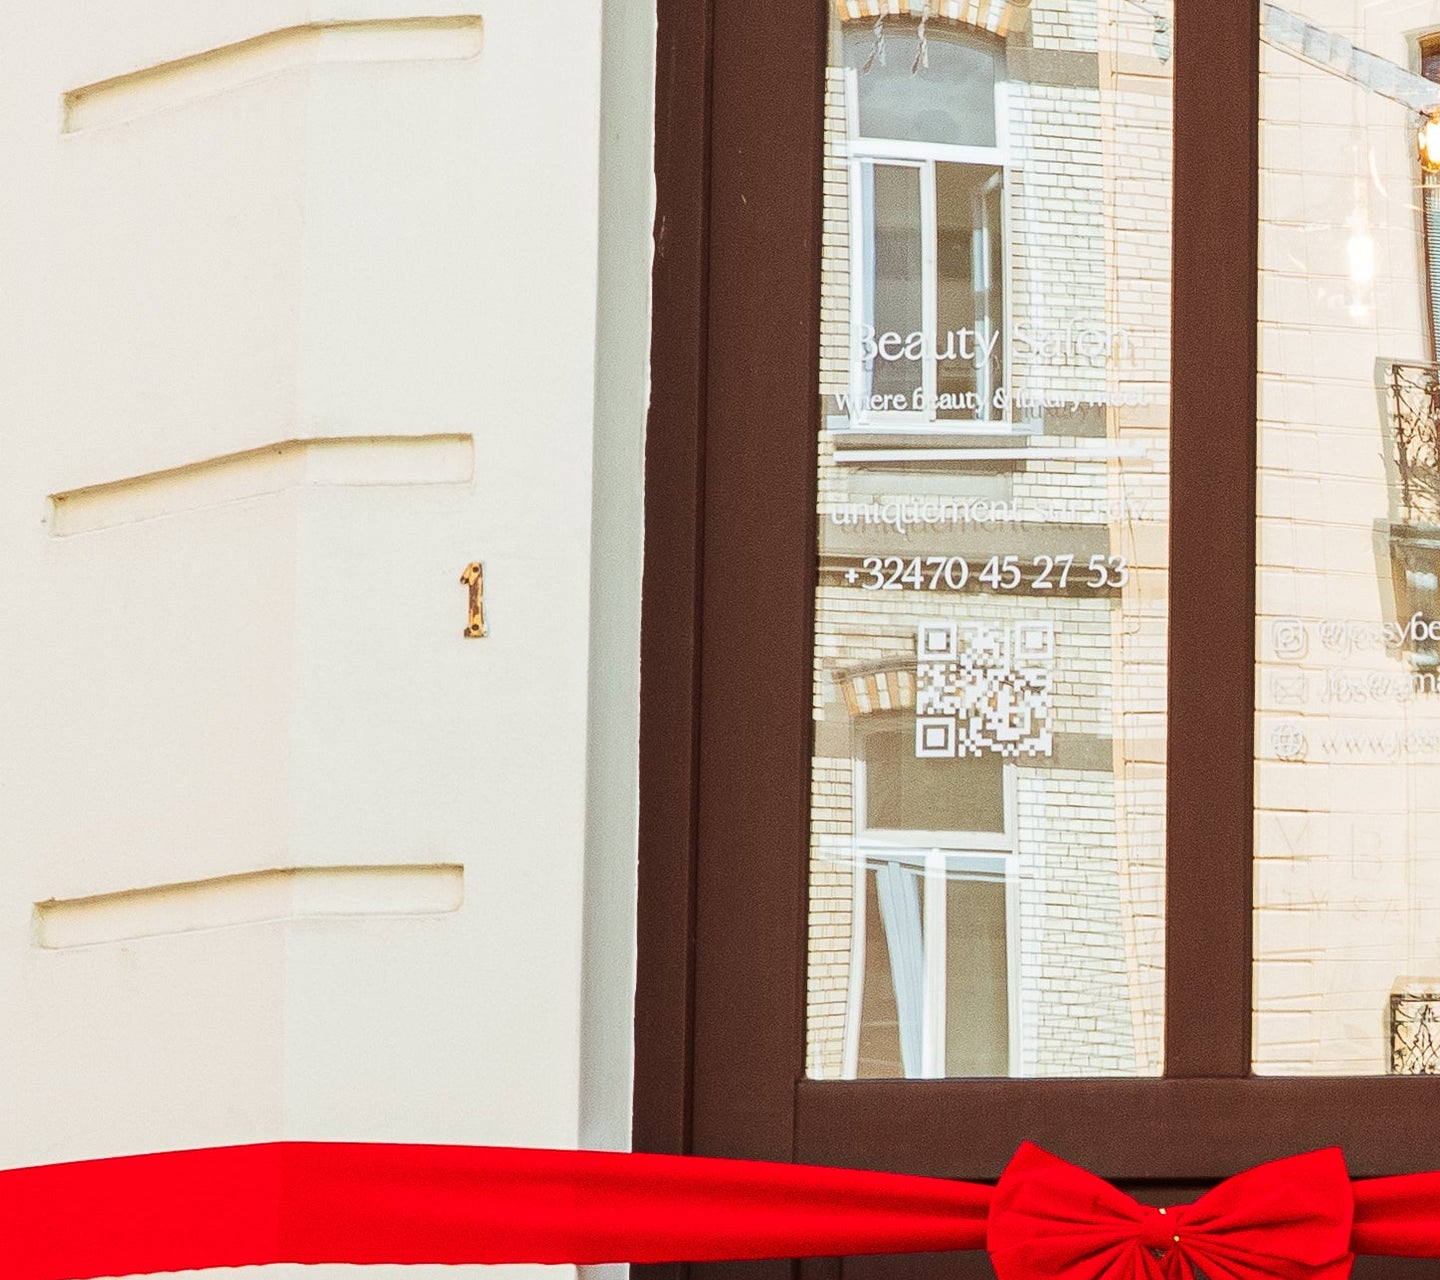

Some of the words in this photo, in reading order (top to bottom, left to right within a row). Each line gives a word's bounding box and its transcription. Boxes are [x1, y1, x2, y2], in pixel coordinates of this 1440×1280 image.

[856, 323, 1000, 369] Beauty
[1013, 317, 1130, 360] Salon
[992, 386, 1008, 409] &
[1016, 386, 1083, 412] luxury
[830, 497, 1019, 535] uniquement
[844, 556, 969, 591] +32470
[978, 555, 1022, 589] 45
[1031, 553, 1074, 589] 27
[1086, 554, 1130, 589] 53
[459, 561, 485, 639] 1
